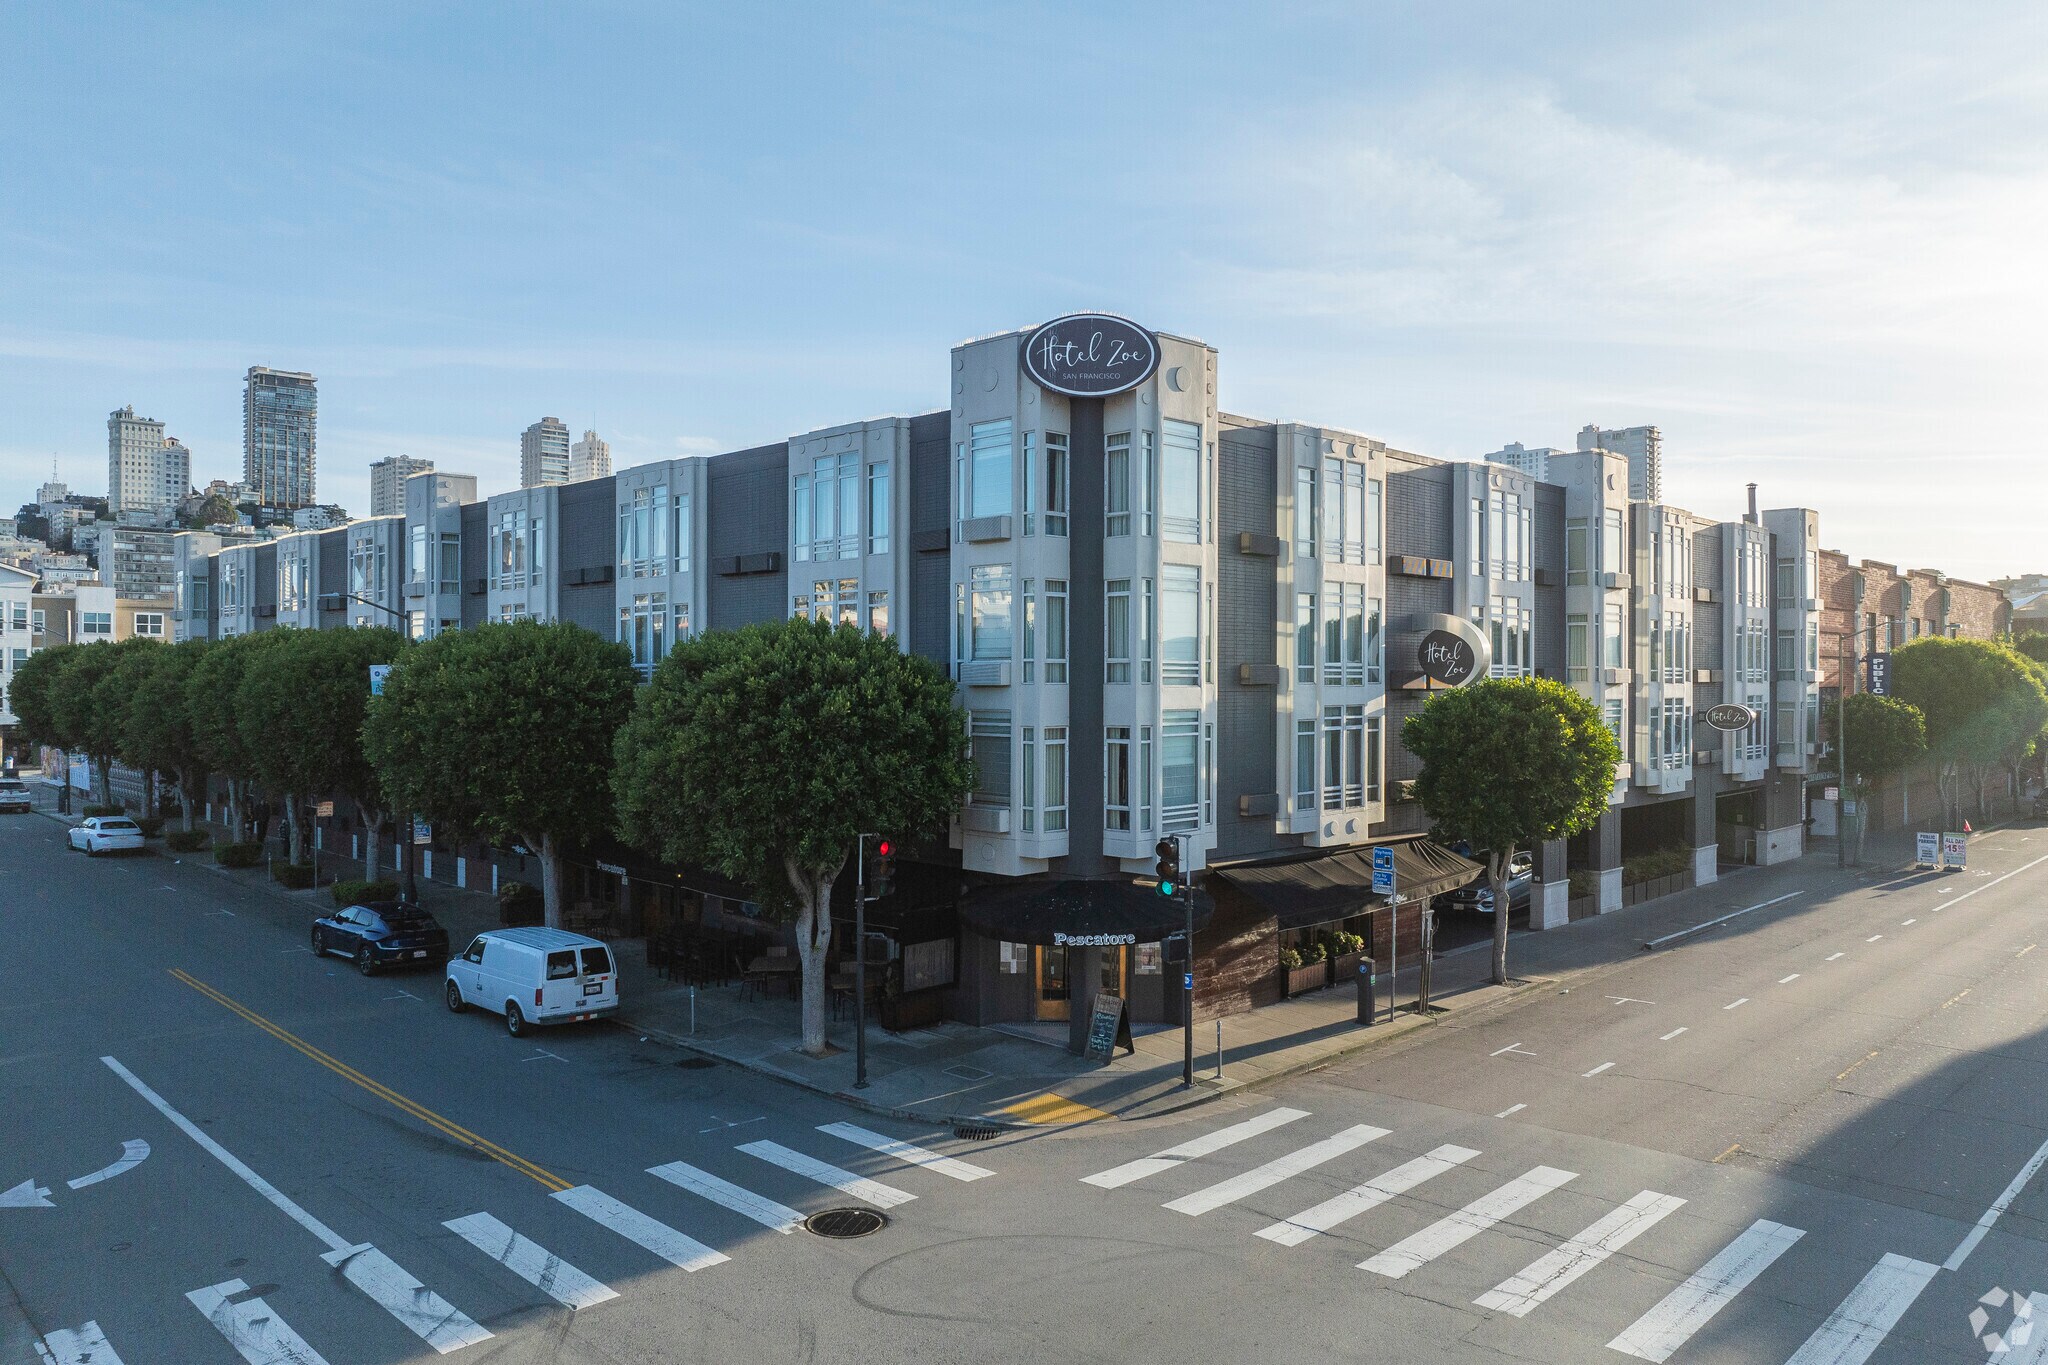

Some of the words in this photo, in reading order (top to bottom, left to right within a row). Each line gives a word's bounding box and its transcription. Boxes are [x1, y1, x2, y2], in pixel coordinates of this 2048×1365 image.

[1036, 331, 1103, 371] Hotel
[1106, 339, 1146, 367] Zoe
[1424, 641, 1463, 664] Hotel
[1444, 660, 1467, 678] Zoe
[1872, 658, 1884, 694] PUBLIC
[1711, 710, 1733, 722] Hotel
[1054, 932, 1136, 946] Pescatore
